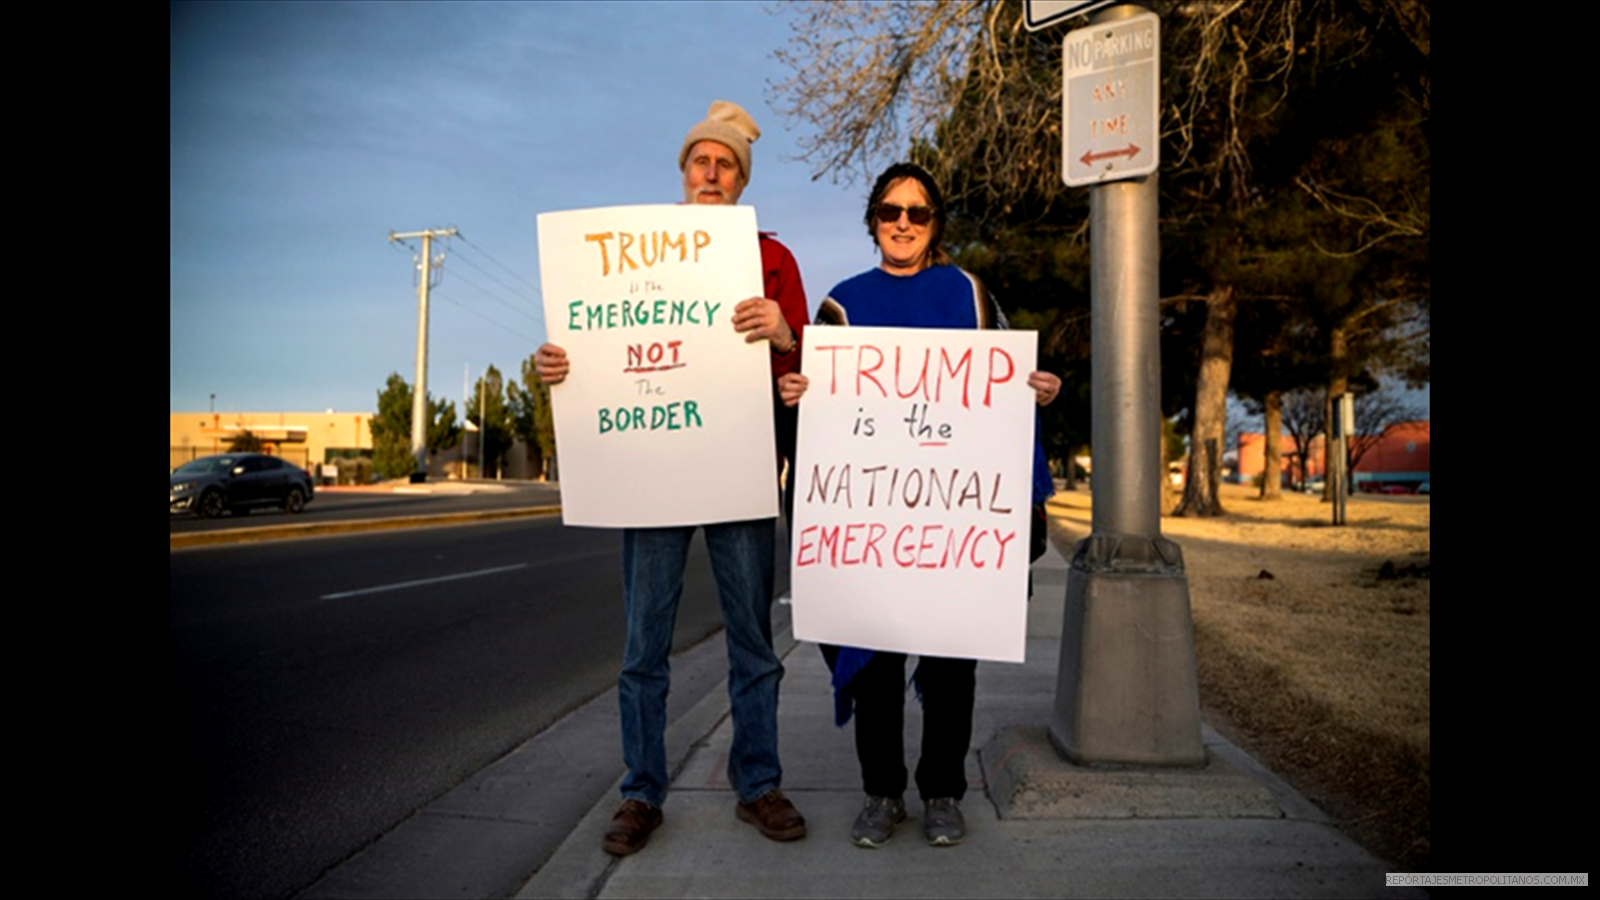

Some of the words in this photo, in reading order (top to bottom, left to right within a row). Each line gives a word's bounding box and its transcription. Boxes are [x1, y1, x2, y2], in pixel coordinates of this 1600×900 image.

[1068, 38, 1093, 70] NO
[1094, 28, 1153, 60] PARKING
[585, 230, 711, 277] TRUMP
[568, 299, 722, 331] EMERGENCY
[627, 340, 683, 366] NOT
[635, 379, 666, 396] The
[815, 345, 1015, 410] TRUMP
[598, 400, 702, 434] BORDER
[853, 407, 876, 437] is
[904, 403, 953, 440] the
[807, 463, 1013, 515] NATIONAL
[796, 522, 1016, 570] EMERGENCY
